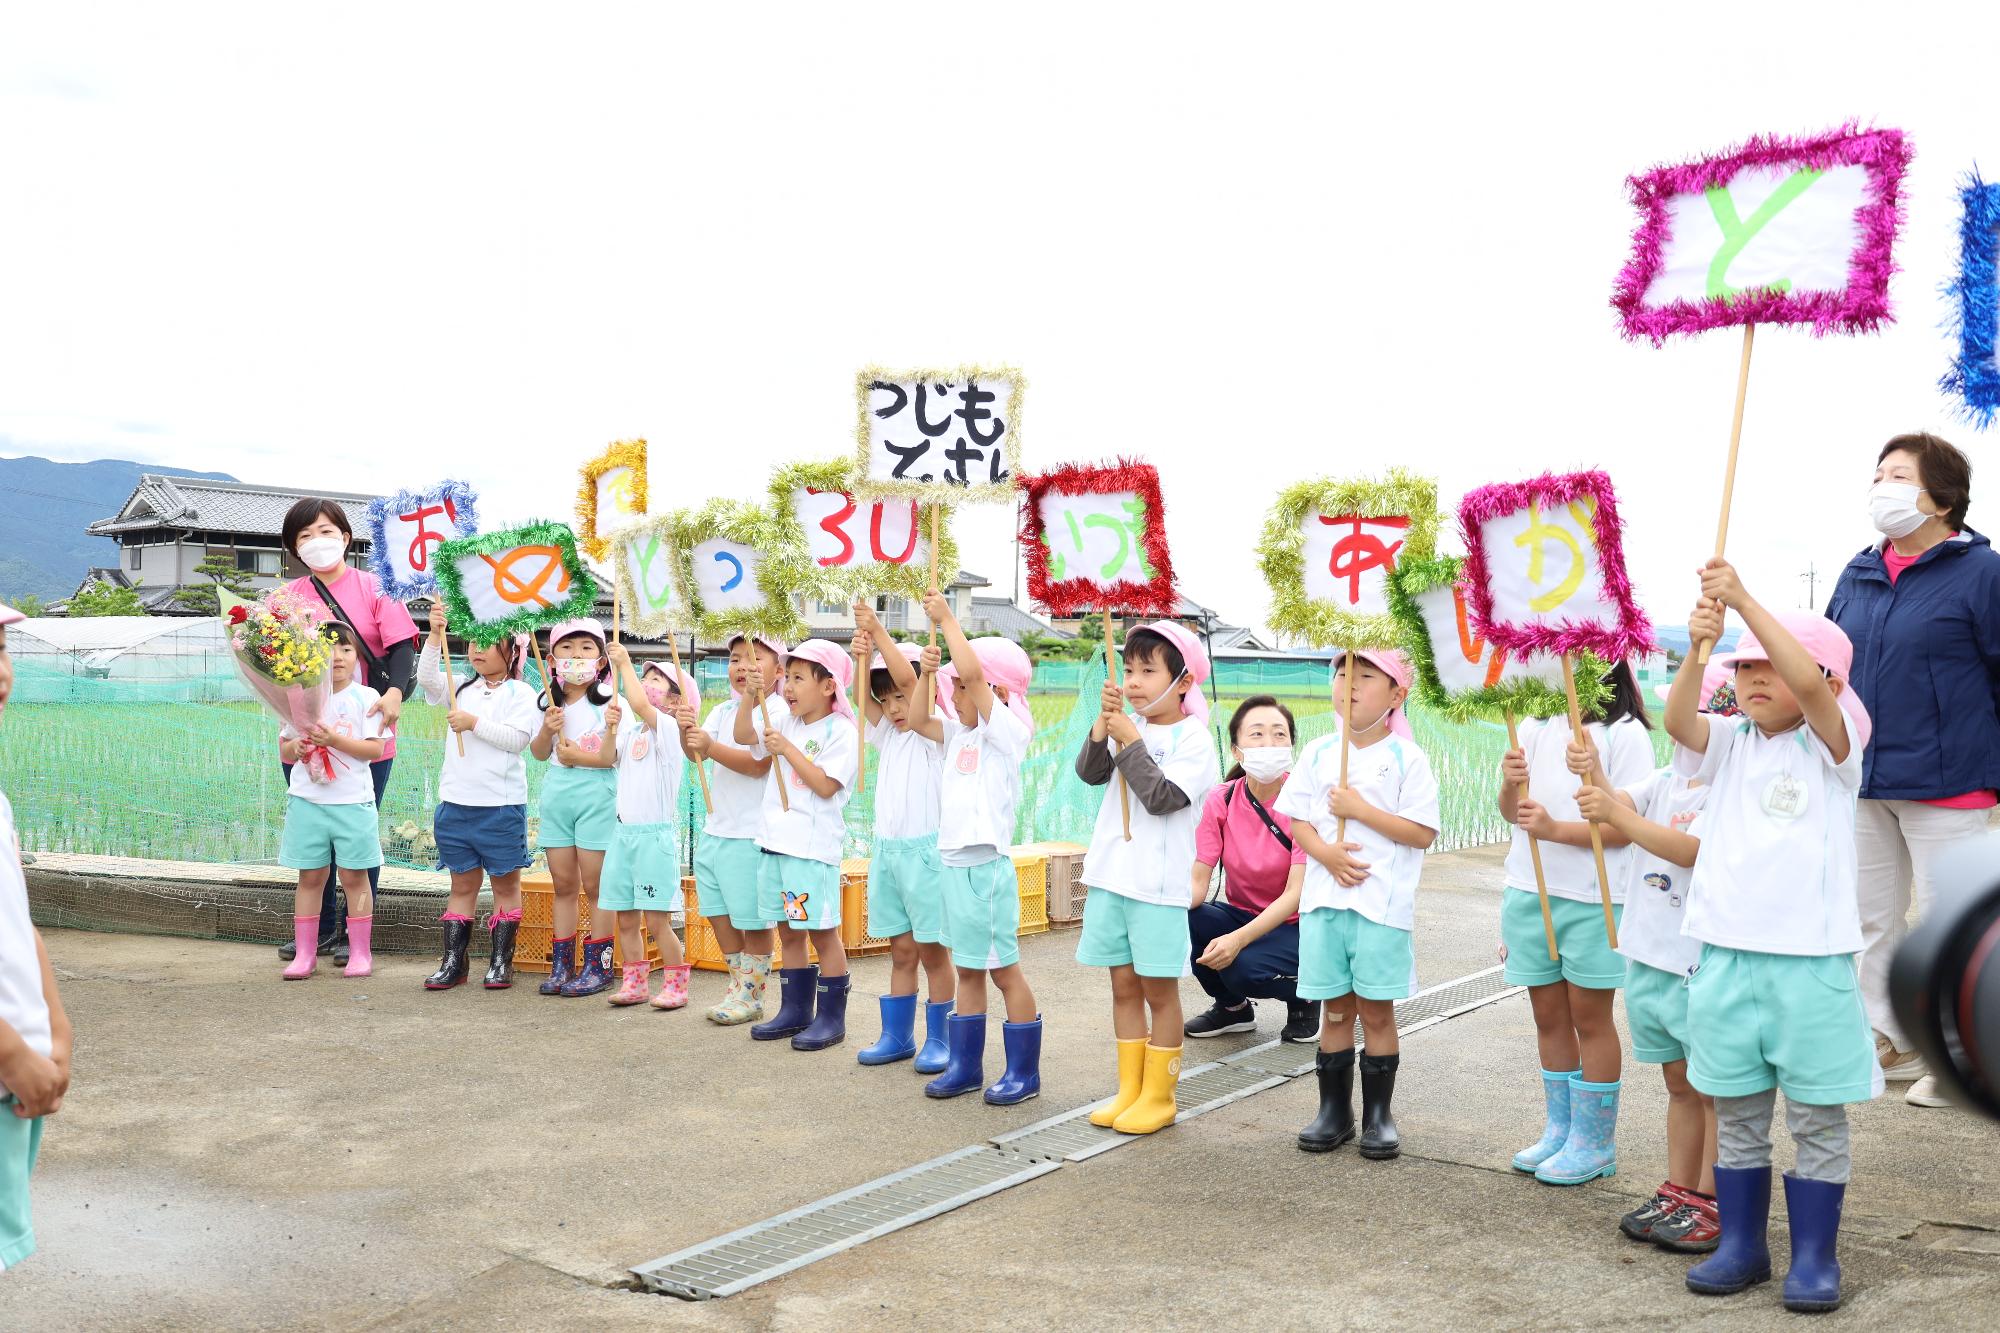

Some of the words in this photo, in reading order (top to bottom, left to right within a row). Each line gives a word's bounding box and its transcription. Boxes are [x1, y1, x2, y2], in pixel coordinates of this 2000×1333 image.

[1704, 165, 1826, 304] と
[867, 377, 1005, 447] つじも
[399, 496, 456, 572] お
[632, 533, 671, 609] と
[1319, 513, 1411, 605] あ
[1514, 495, 1602, 613] が
